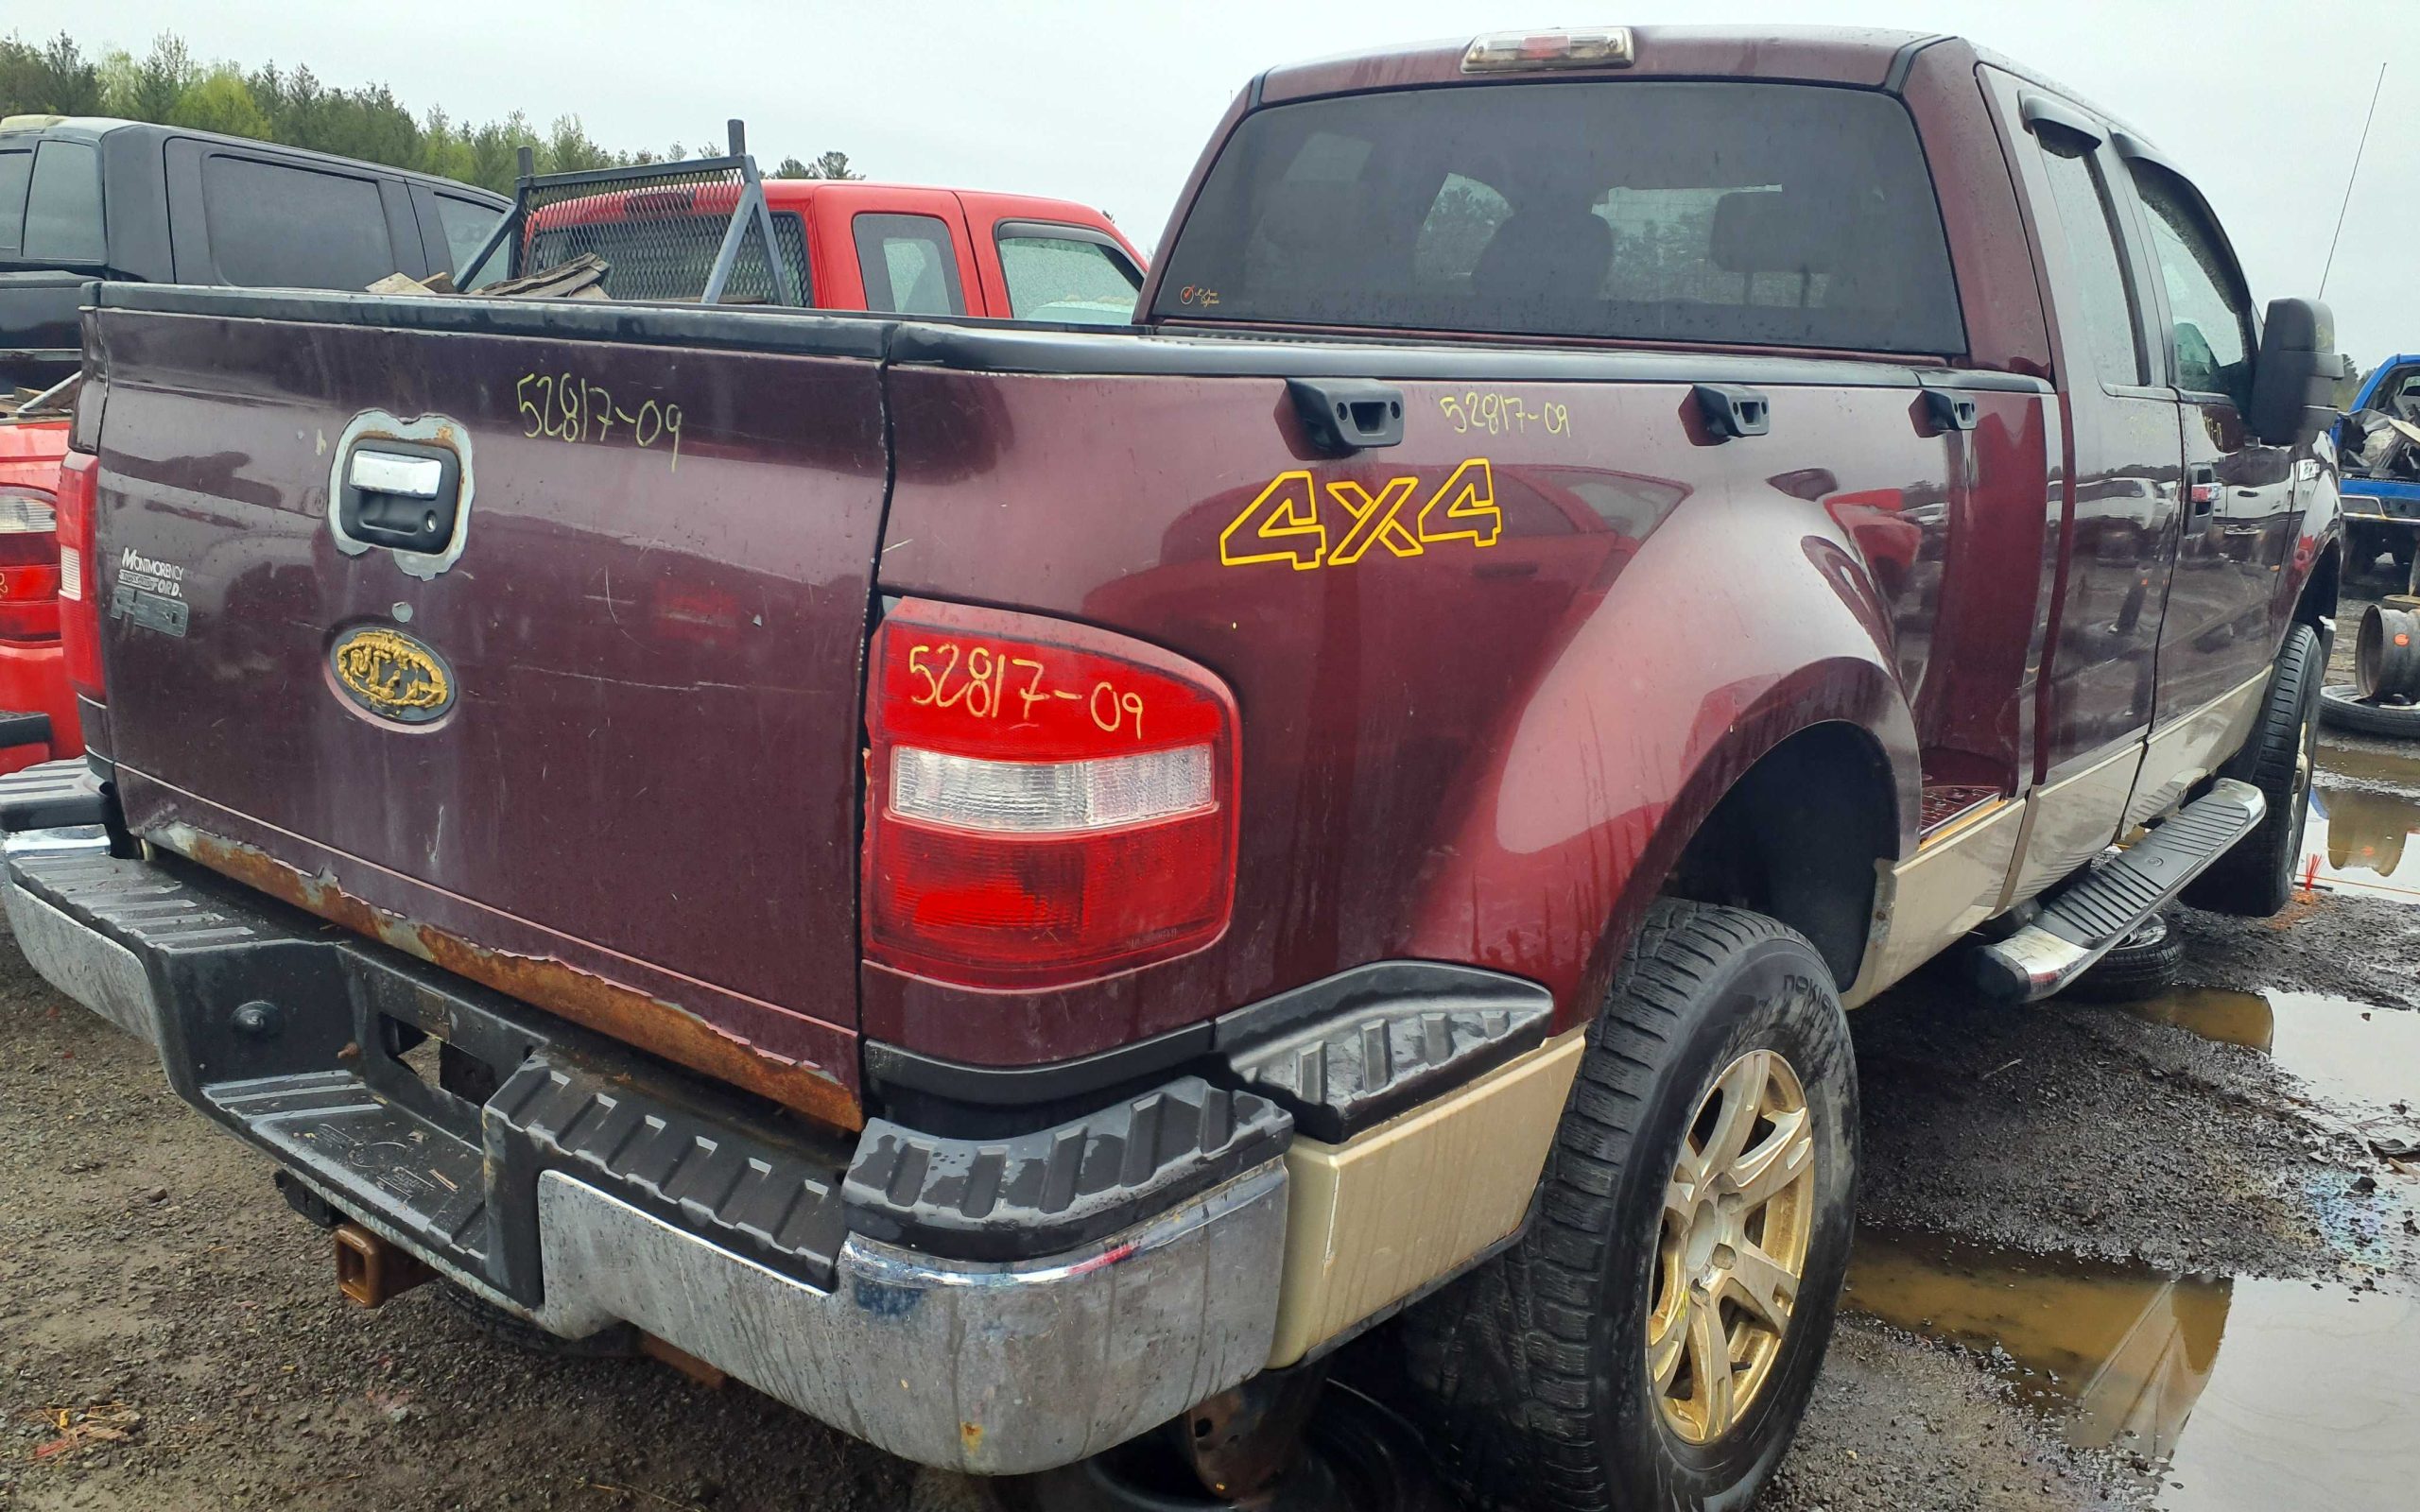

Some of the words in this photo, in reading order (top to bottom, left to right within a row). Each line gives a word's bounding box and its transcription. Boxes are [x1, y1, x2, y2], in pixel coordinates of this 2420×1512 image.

[516, 372, 683, 472] 52817-09
[1439, 391, 1570, 438] 52817-09
[908, 643, 1143, 740] 52817-09
